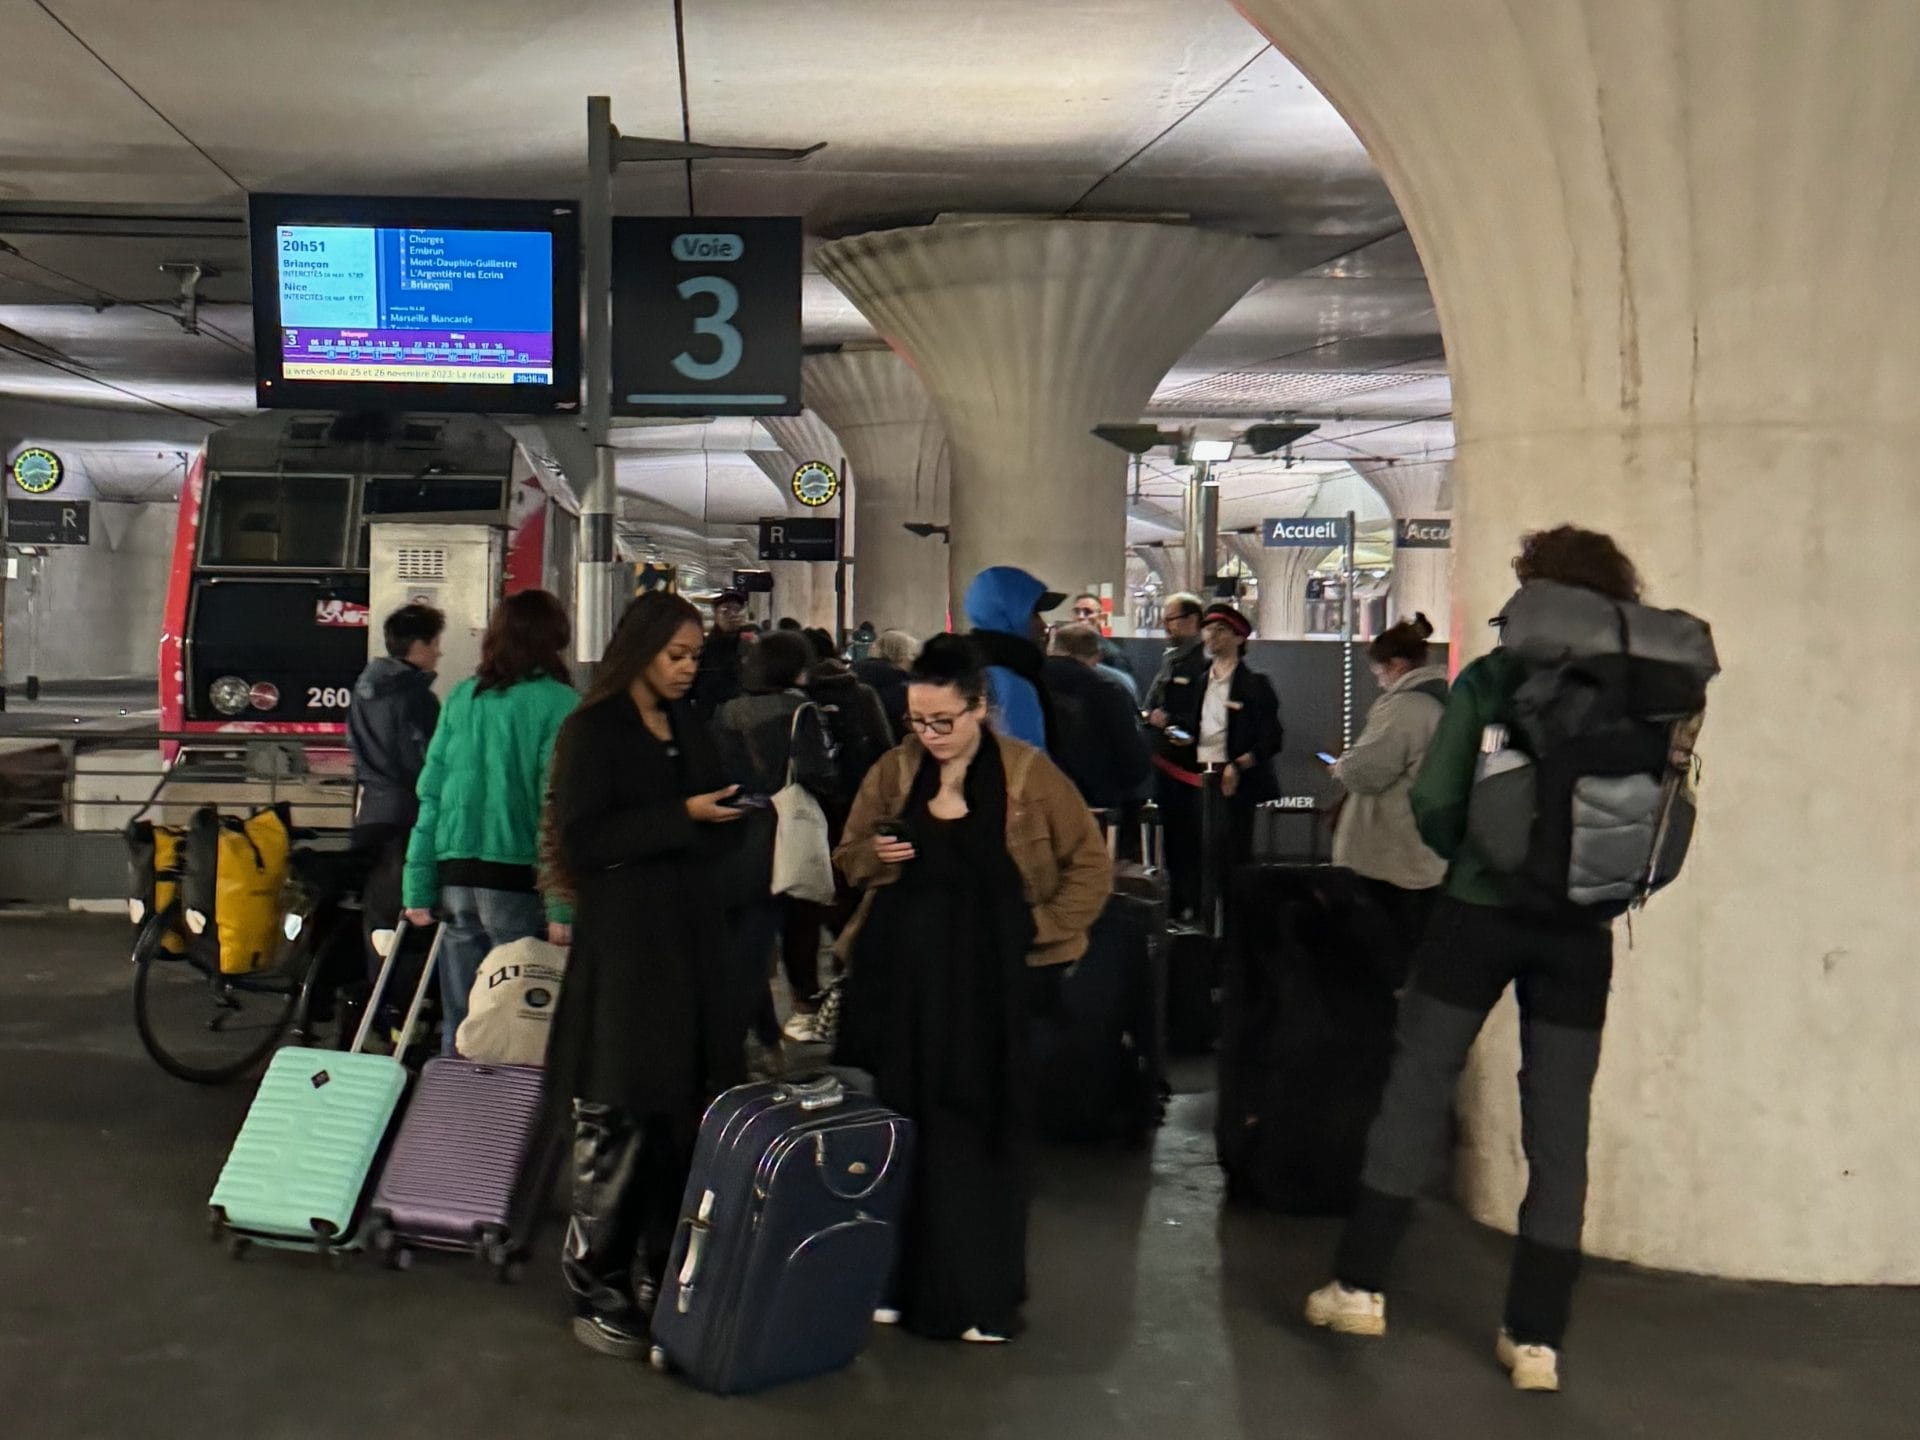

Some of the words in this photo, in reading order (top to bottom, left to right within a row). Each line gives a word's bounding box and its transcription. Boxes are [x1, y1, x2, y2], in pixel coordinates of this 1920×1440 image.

[283, 240, 325, 252] 20h51
[409, 246, 444, 255] Embrun
[683, 238, 733, 257] Voie
[283, 259, 329, 269] Briançon
[463, 270, 476, 278] les
[284, 283, 308, 291] Nice
[411, 281, 451, 291] Briançon
[391, 314, 429, 323] Marseille
[431, 315, 473, 324] Blancarde
[671, 275, 743, 380] 3
[288, 335, 297, 345] 3
[374, 369, 384, 377] 26
[62, 508, 76, 528] R
[770, 526, 784, 544] R
[1272, 521, 1337, 539] Accueil
[307, 687, 351, 708] 260
